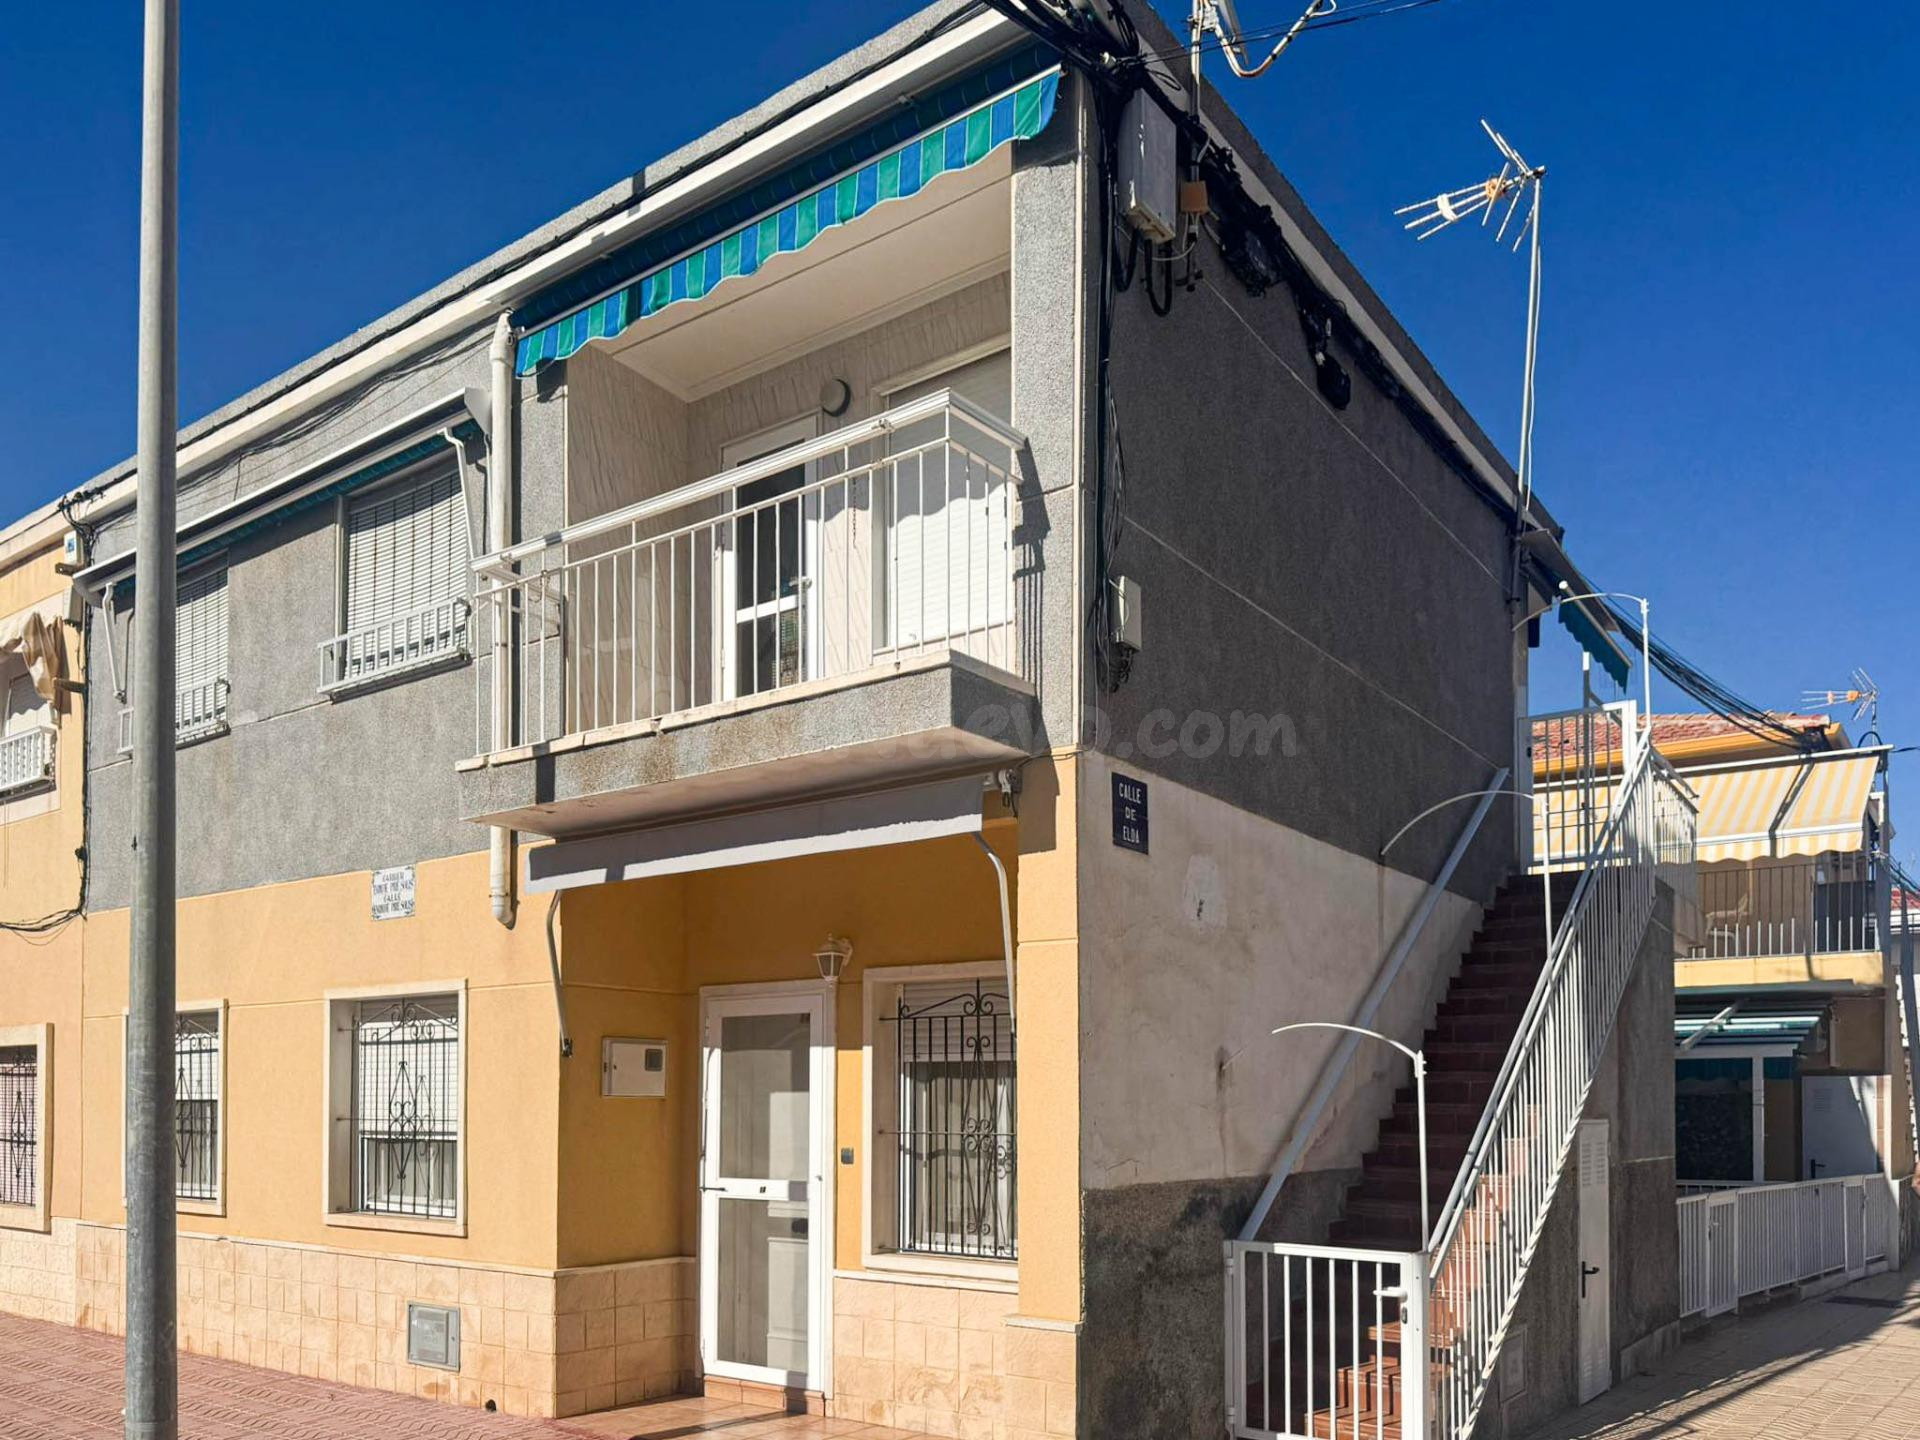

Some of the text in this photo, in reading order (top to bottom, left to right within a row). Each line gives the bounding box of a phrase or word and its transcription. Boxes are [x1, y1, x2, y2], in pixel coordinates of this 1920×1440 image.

[1119, 782, 1142, 804] CALLE
[1125, 806, 1137, 821] DE
[1123, 825, 1140, 844] ELDA
